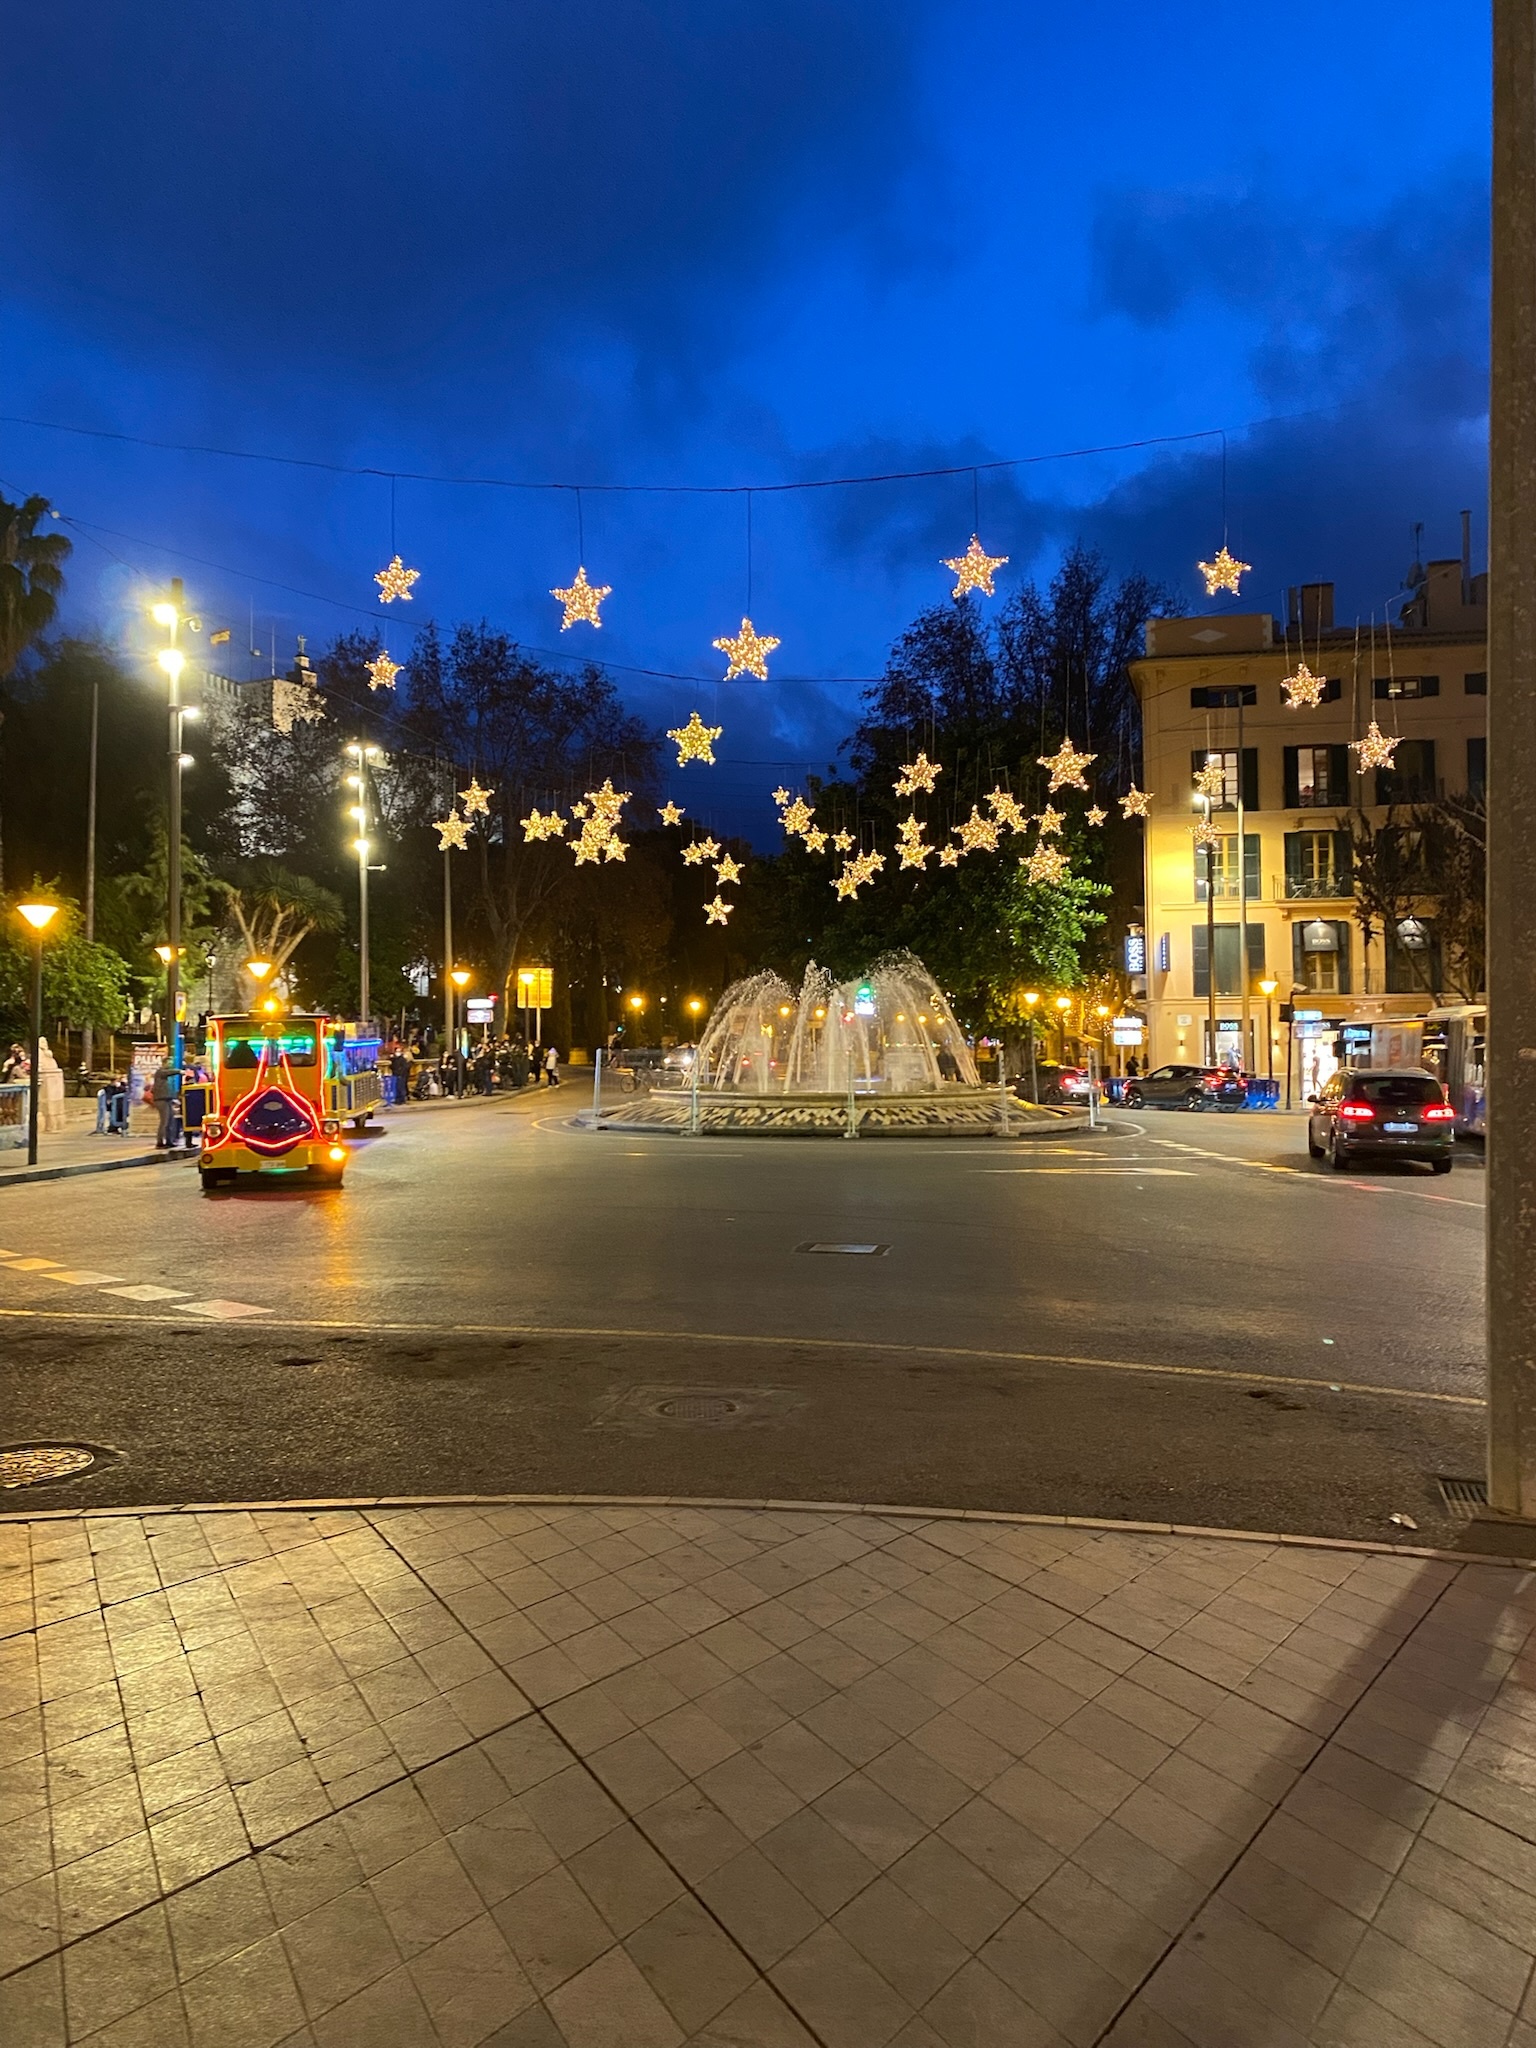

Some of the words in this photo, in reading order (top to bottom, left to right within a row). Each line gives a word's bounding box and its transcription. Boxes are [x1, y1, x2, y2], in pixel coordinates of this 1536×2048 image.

[1311, 938, 1331, 946] BOSS
[1128, 937, 1140, 972] BOSS
[1219, 1022, 1239, 1031] BOSS
[134, 1055, 163, 1066] PALM
